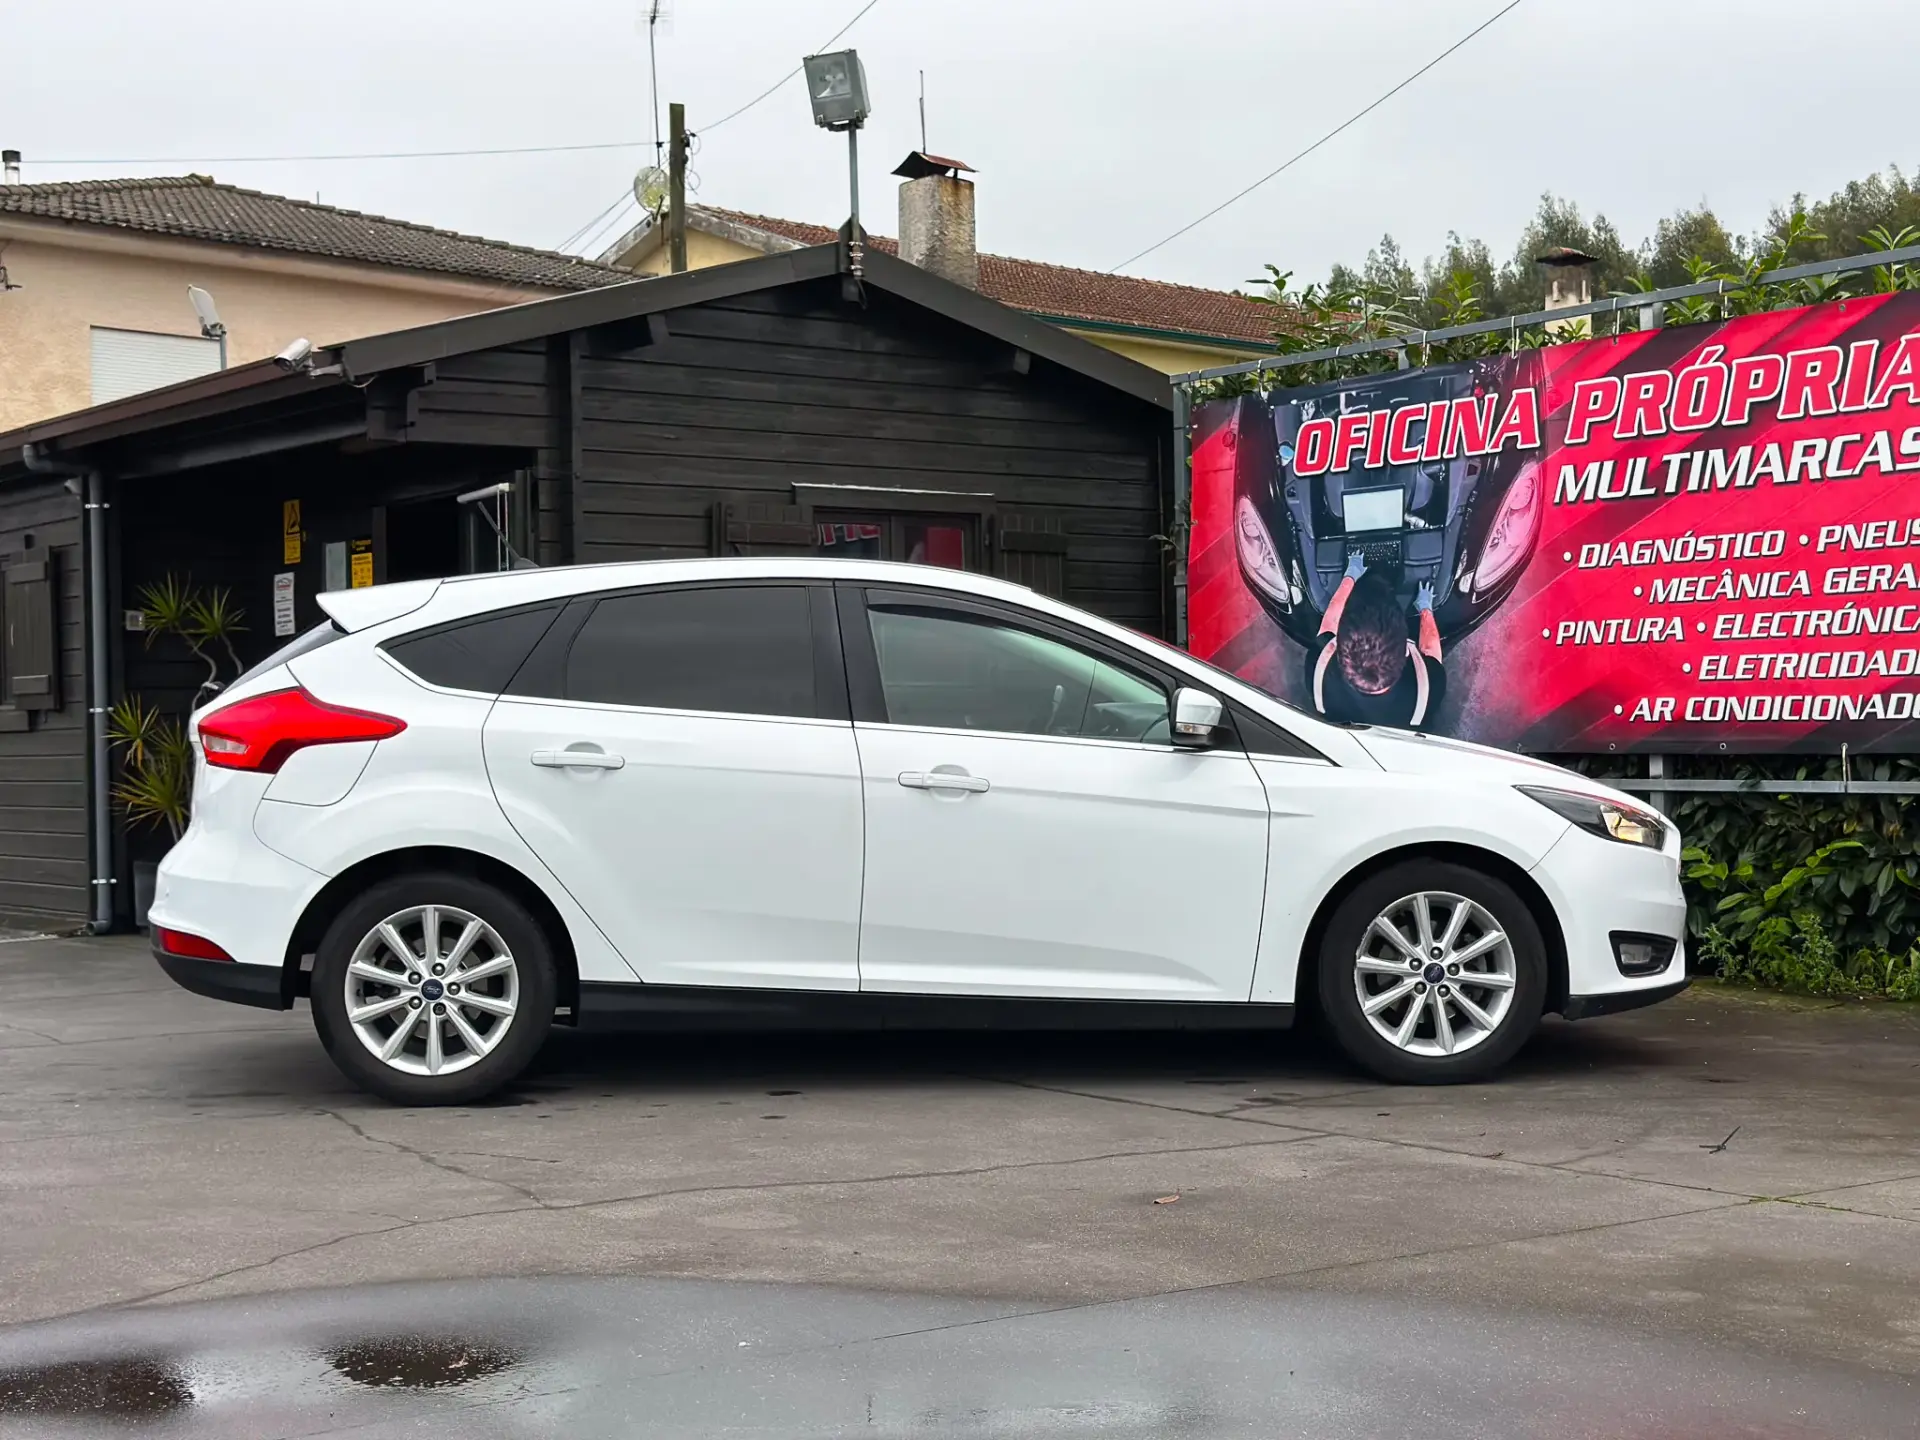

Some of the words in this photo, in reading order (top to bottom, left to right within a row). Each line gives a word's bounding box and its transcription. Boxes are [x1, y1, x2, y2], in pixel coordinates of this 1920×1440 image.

[1293, 388, 1541, 476] OFICINA
[1564, 333, 1920, 445] PRÓPRIA
[1553, 427, 1920, 504] MULTIMARCAS
[1578, 530, 1786, 569] DIAGNÓSTICO
[1649, 568, 1811, 603] MECÂNICA
[1822, 563, 1920, 594] GERA
[1555, 616, 1684, 645] PINTURA
[1712, 602, 1920, 639] ELECTRÓNIC
[1698, 649, 1920, 681] ELETRICIDAD
[1629, 697, 1677, 722] AR
